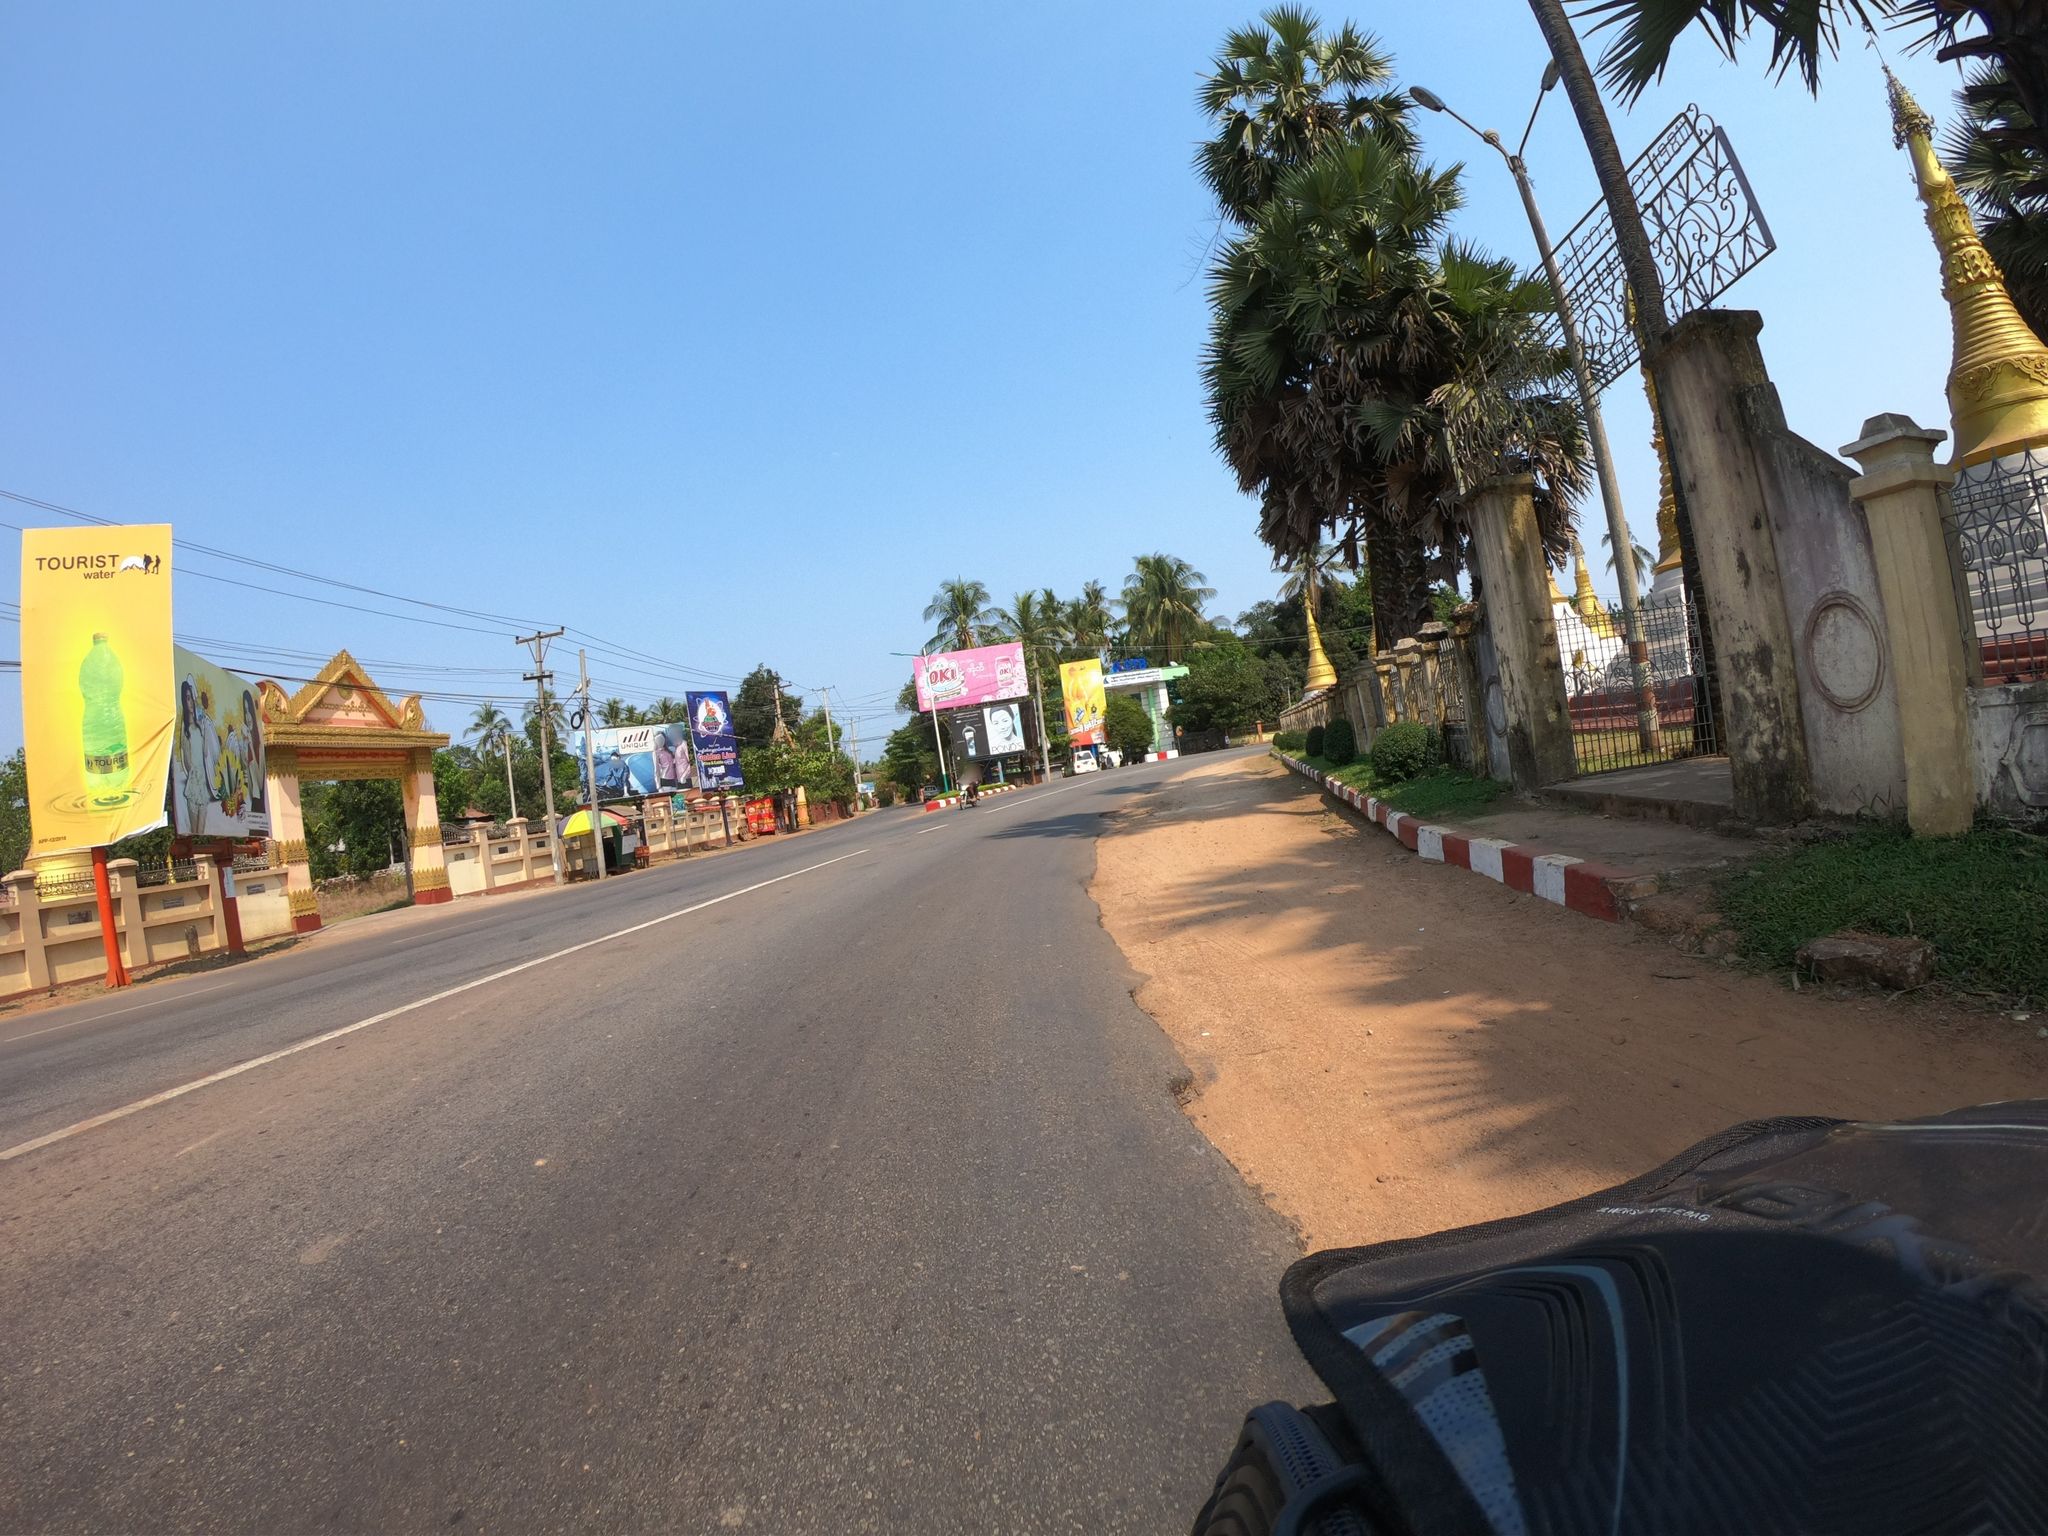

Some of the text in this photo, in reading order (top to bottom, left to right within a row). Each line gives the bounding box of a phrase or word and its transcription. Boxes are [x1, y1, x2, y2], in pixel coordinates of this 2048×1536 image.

[35, 554, 120, 571] TOURIST
[83, 569, 116, 580] water
[621, 741, 649, 750] UNIQUE
